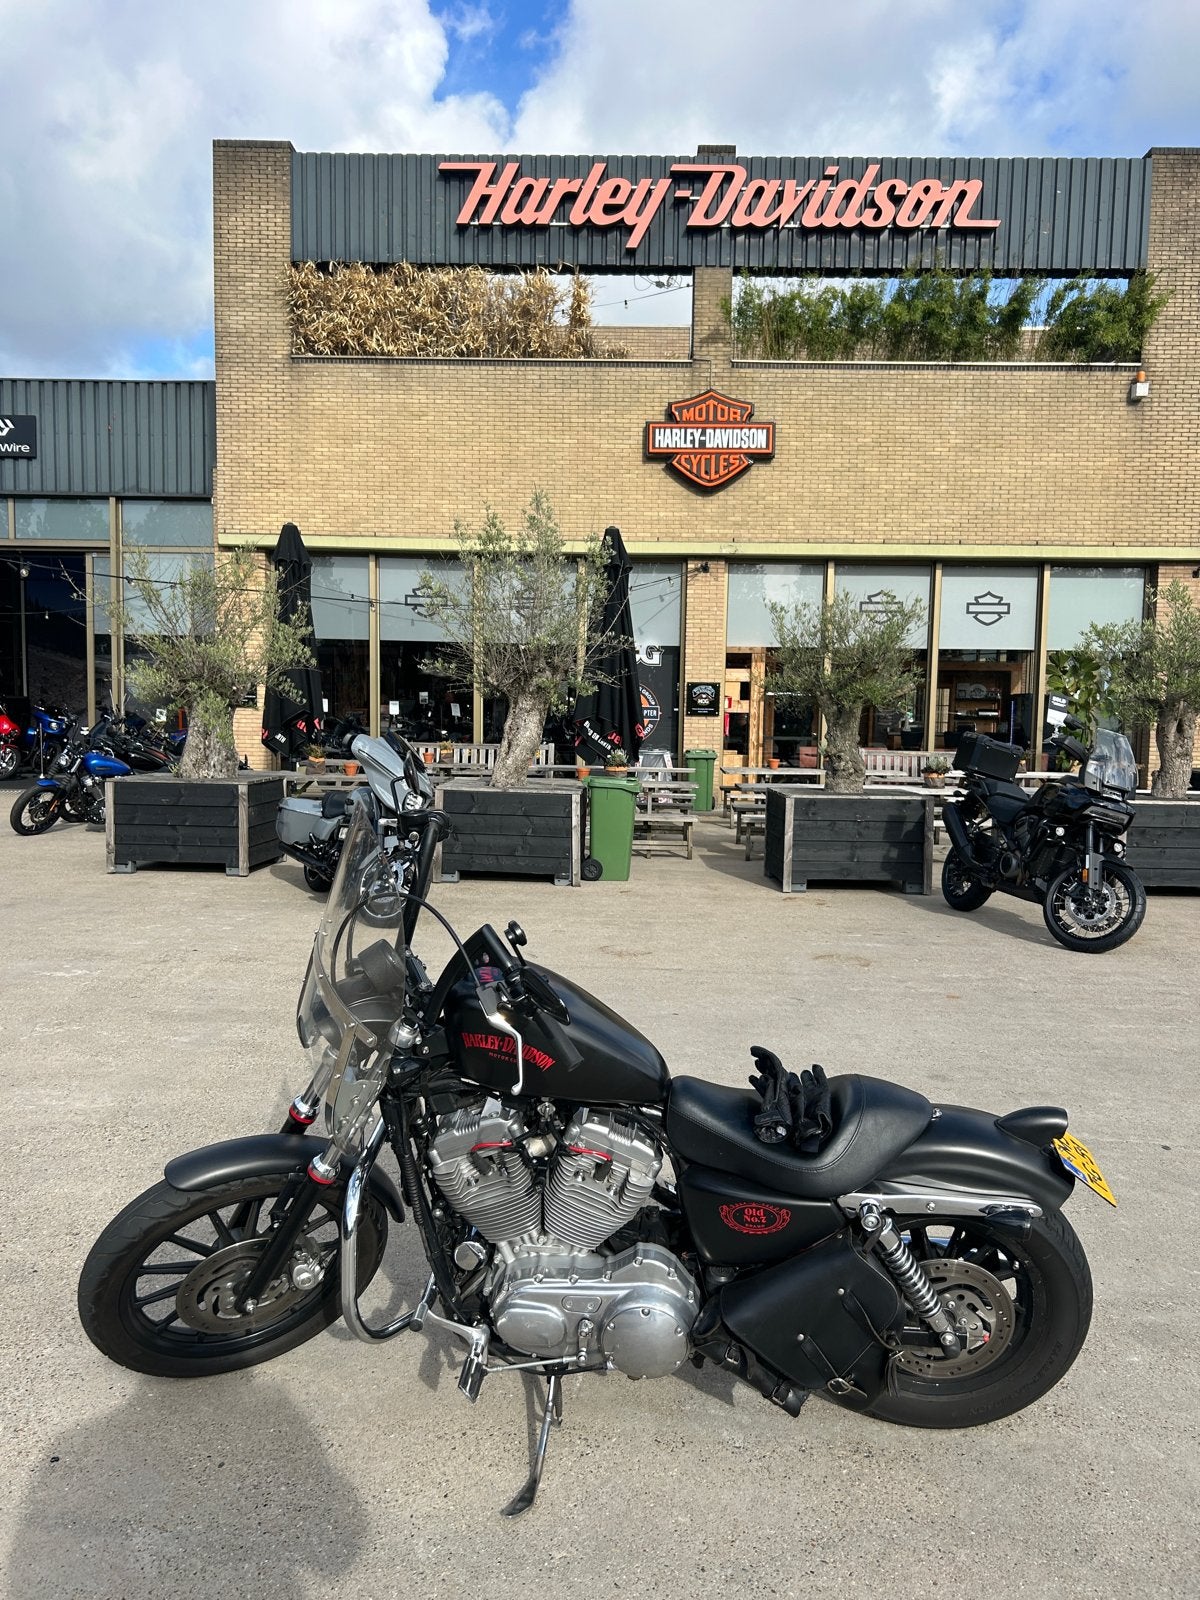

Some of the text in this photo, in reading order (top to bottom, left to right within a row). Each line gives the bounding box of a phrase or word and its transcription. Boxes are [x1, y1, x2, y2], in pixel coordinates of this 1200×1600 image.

[438, 163, 1001, 248] Harley-Davidson
[682, 399, 741, 422] MOTOR
[655, 428, 767, 449] HARLEY-DAVIDSON
[680, 454, 741, 481] CYCLES
[643, 709, 657, 717] PTER
[461, 1032, 556, 1072] HARLEY-DAIDSON
[744, 1208, 764, 1217] Old
